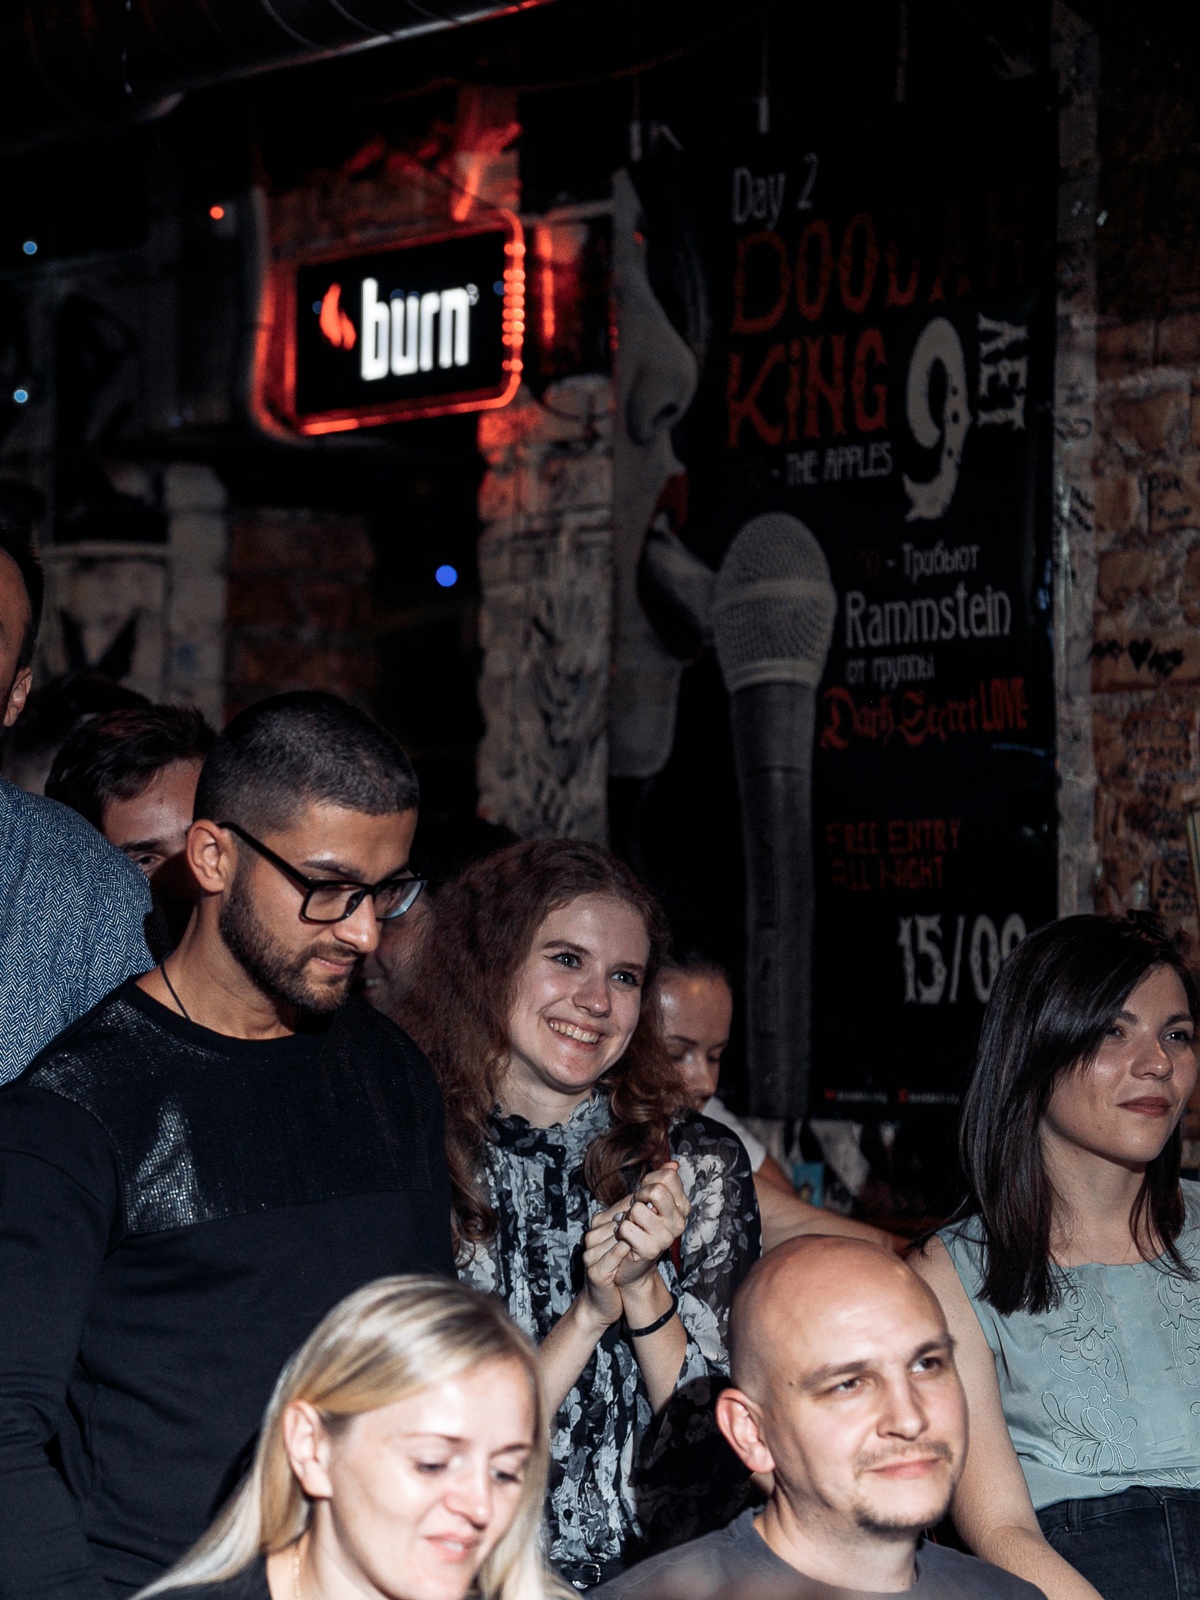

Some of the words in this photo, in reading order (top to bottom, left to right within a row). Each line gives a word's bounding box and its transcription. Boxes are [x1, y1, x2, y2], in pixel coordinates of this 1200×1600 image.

[731, 164, 788, 232] Day
[795, 150, 821, 212] 2
[360, 276, 471, 382] burn
[903, 315, 974, 523] 9
[785, 451, 820, 487] THE
[822, 440, 895, 483] APPLES
[844, 579, 1013, 650] Rammstein
[825, 820, 881, 856] FREE
[886, 817, 962, 855] ENTRY
[830, 858, 872, 892] ALL
[878, 855, 945, 891] NIGHT
